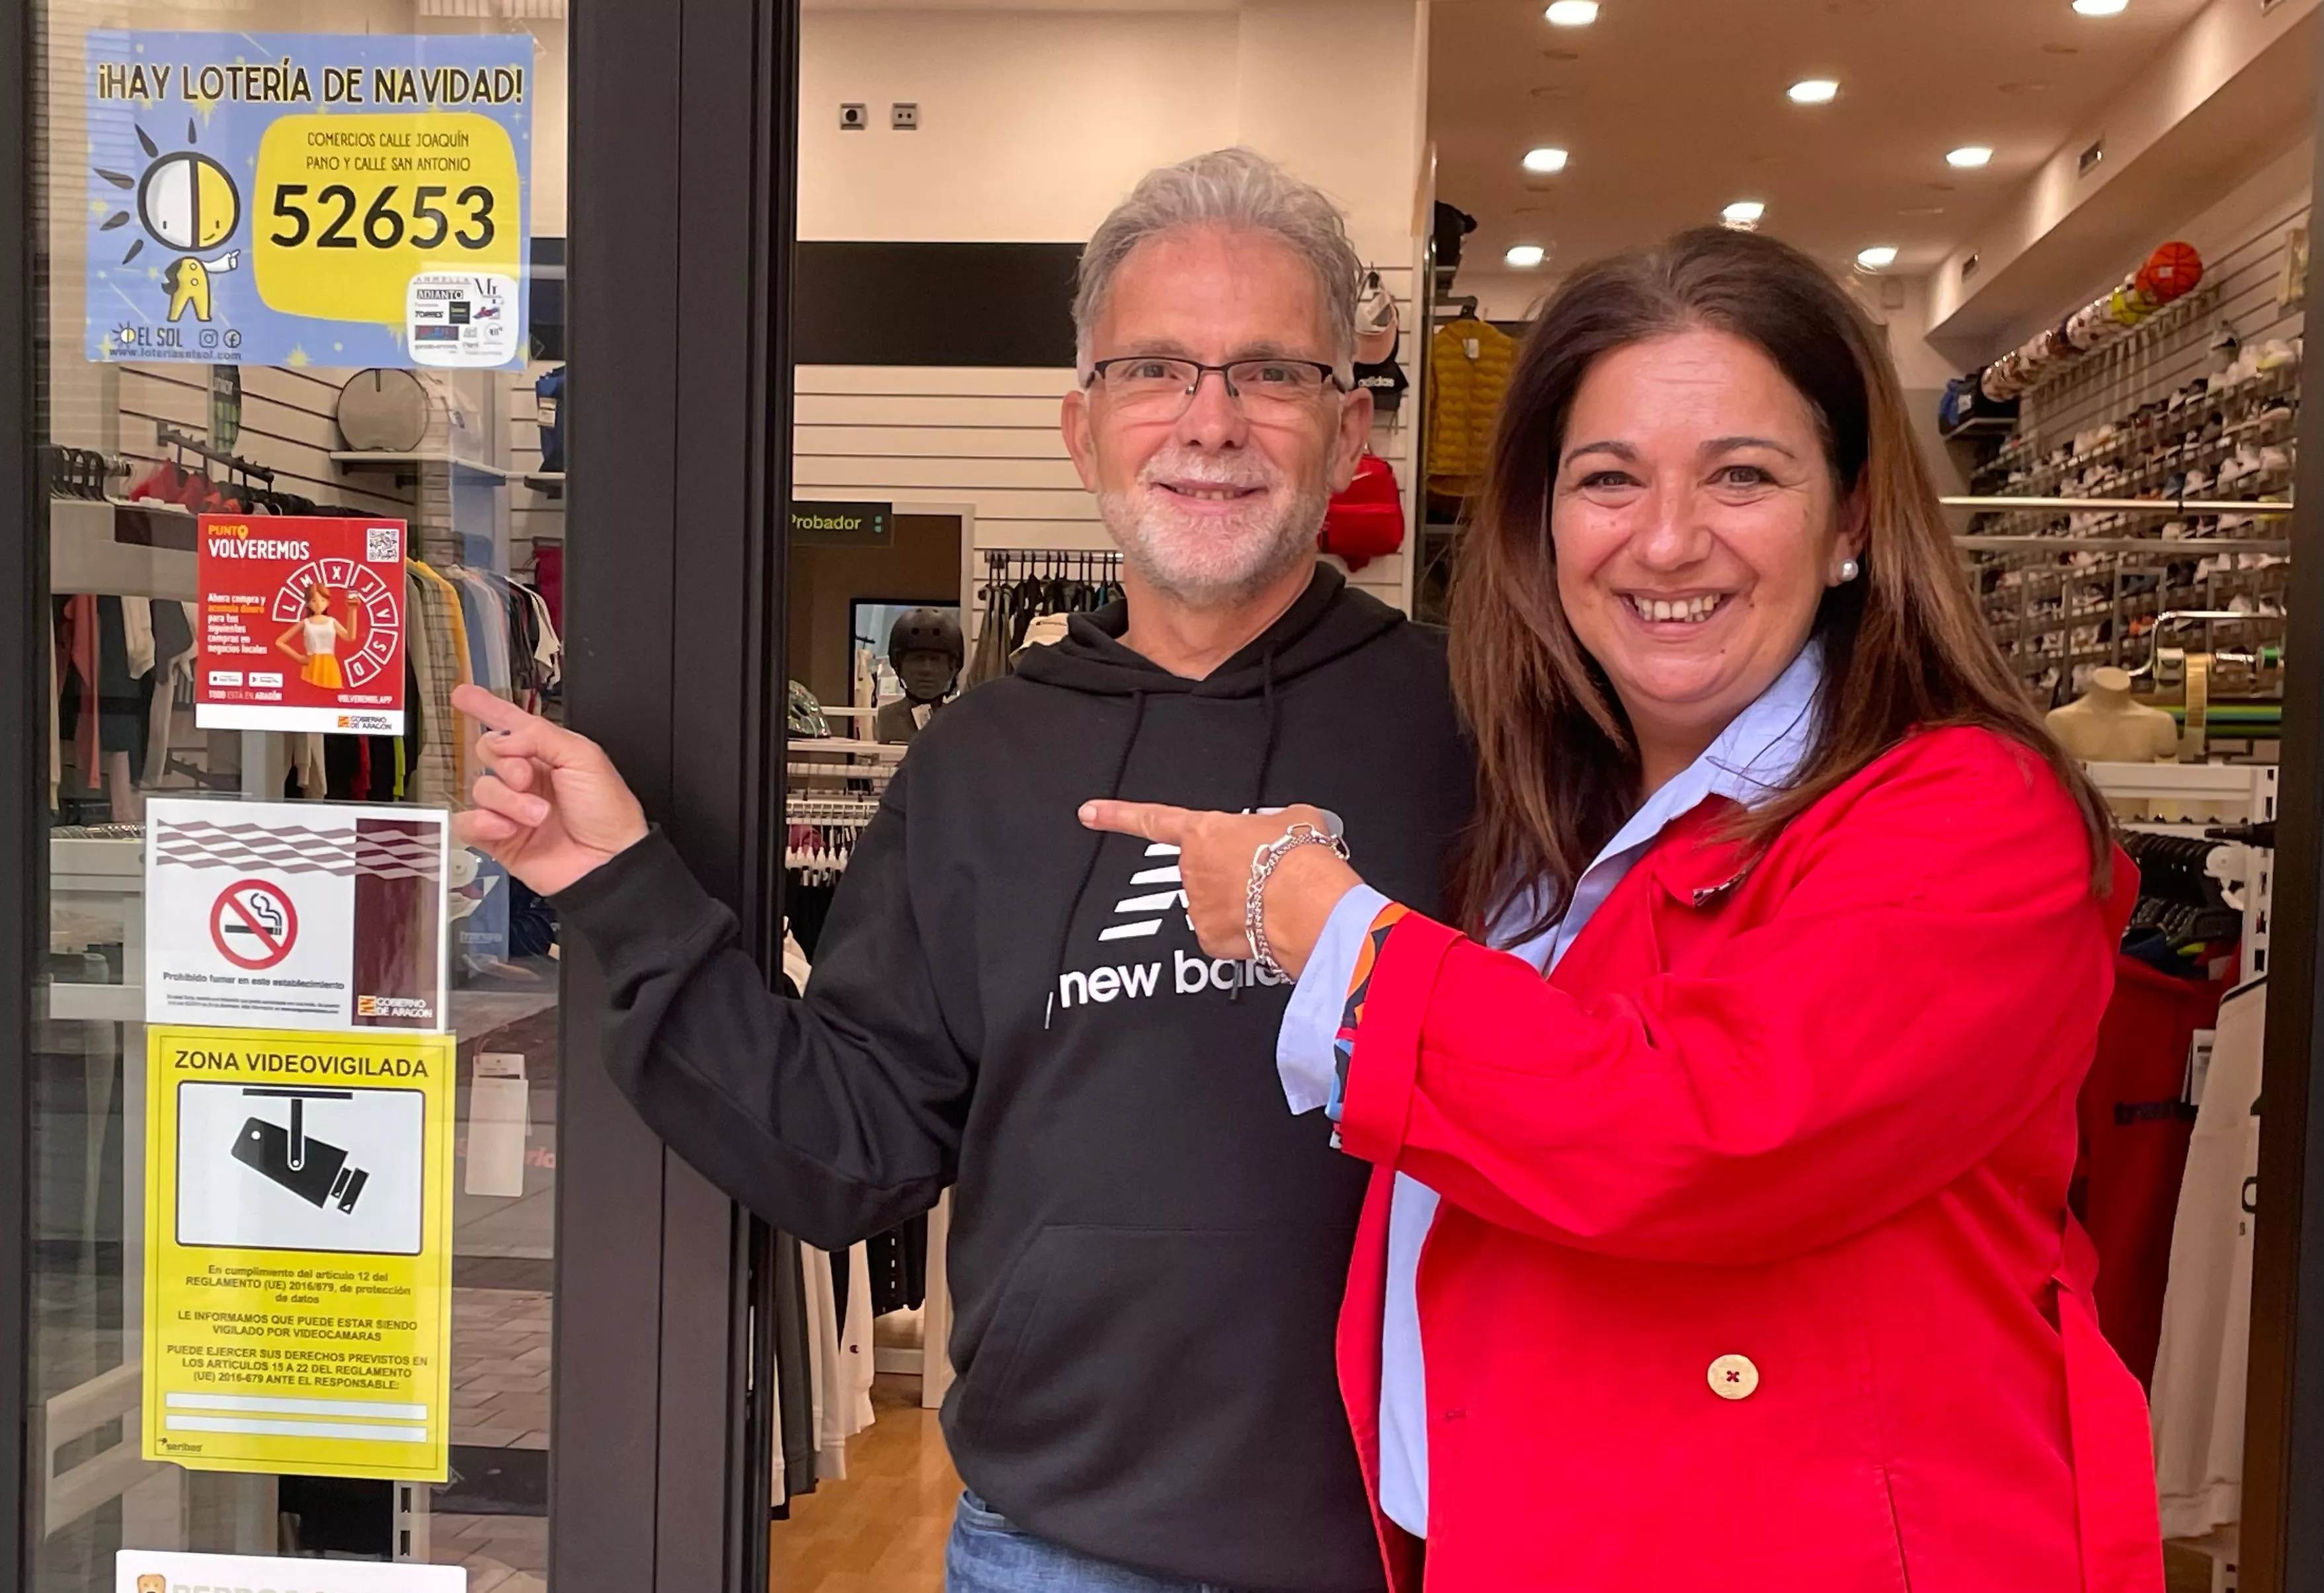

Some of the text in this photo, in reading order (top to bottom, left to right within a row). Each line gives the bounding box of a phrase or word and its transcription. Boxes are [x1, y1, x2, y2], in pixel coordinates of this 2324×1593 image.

[99, 57, 522, 103] ¡HAY LOTERÍA DE NAVIDAD!
[308, 130, 469, 147] COMERCIOS CALLE JOAQUÍN
[306, 156, 471, 172] PANO Y CALLE SAN ANTONIO
[270, 184, 495, 250] 52653
[417, 290, 463, 299] ADIANTO
[138, 326, 183, 348] EL SOL
[208, 538, 310, 561] VOLVEREMOS
[332, 566, 342, 580] X
[163, 972, 207, 982] Prohibido
[1059, 962, 1161, 1008] new
[175, 1050, 429, 1077] ZONA VIDEOVIGILADA
[208, 1264, 221, 1274] En
[225, 1266, 294, 1278] cumplimiento
[298, 1269, 313, 1278] del
[358, 1272, 370, 1281] 12
[372, 1272, 388, 1282] del
[186, 1276, 261, 1288] REGLAMENTO
[264, 1280, 286, 1292] (UE)
[340, 1284, 352, 1293] de
[355, 1285, 411, 1296] protección
[275, 1293, 319, 1303] de datos
[178, 1310, 418, 1331] LE INFORMAMOS QUE PUEDE ESTAR SIENDO
[213, 1325, 381, 1342] VIGILADO POR VIDEOCAMARAS
[167, 1344, 428, 1366] PUEDE EJERCER SUS DERECHOS PREVISTOS EN
[182, 1357, 204, 1368] LOS
[272, 1363, 283, 1372] 15
[286, 1363, 294, 1372] A
[296, 1364, 308, 1374] 22
[311, 1364, 332, 1374] DEL
[335, 1366, 413, 1378] REGLAMENTO
[194, 1370, 216, 1383] (UE)
[266, 1374, 295, 1385] ANTE
[298, 1376, 311, 1385] EL
[314, 1378, 399, 1390] RESPONSABLE:
